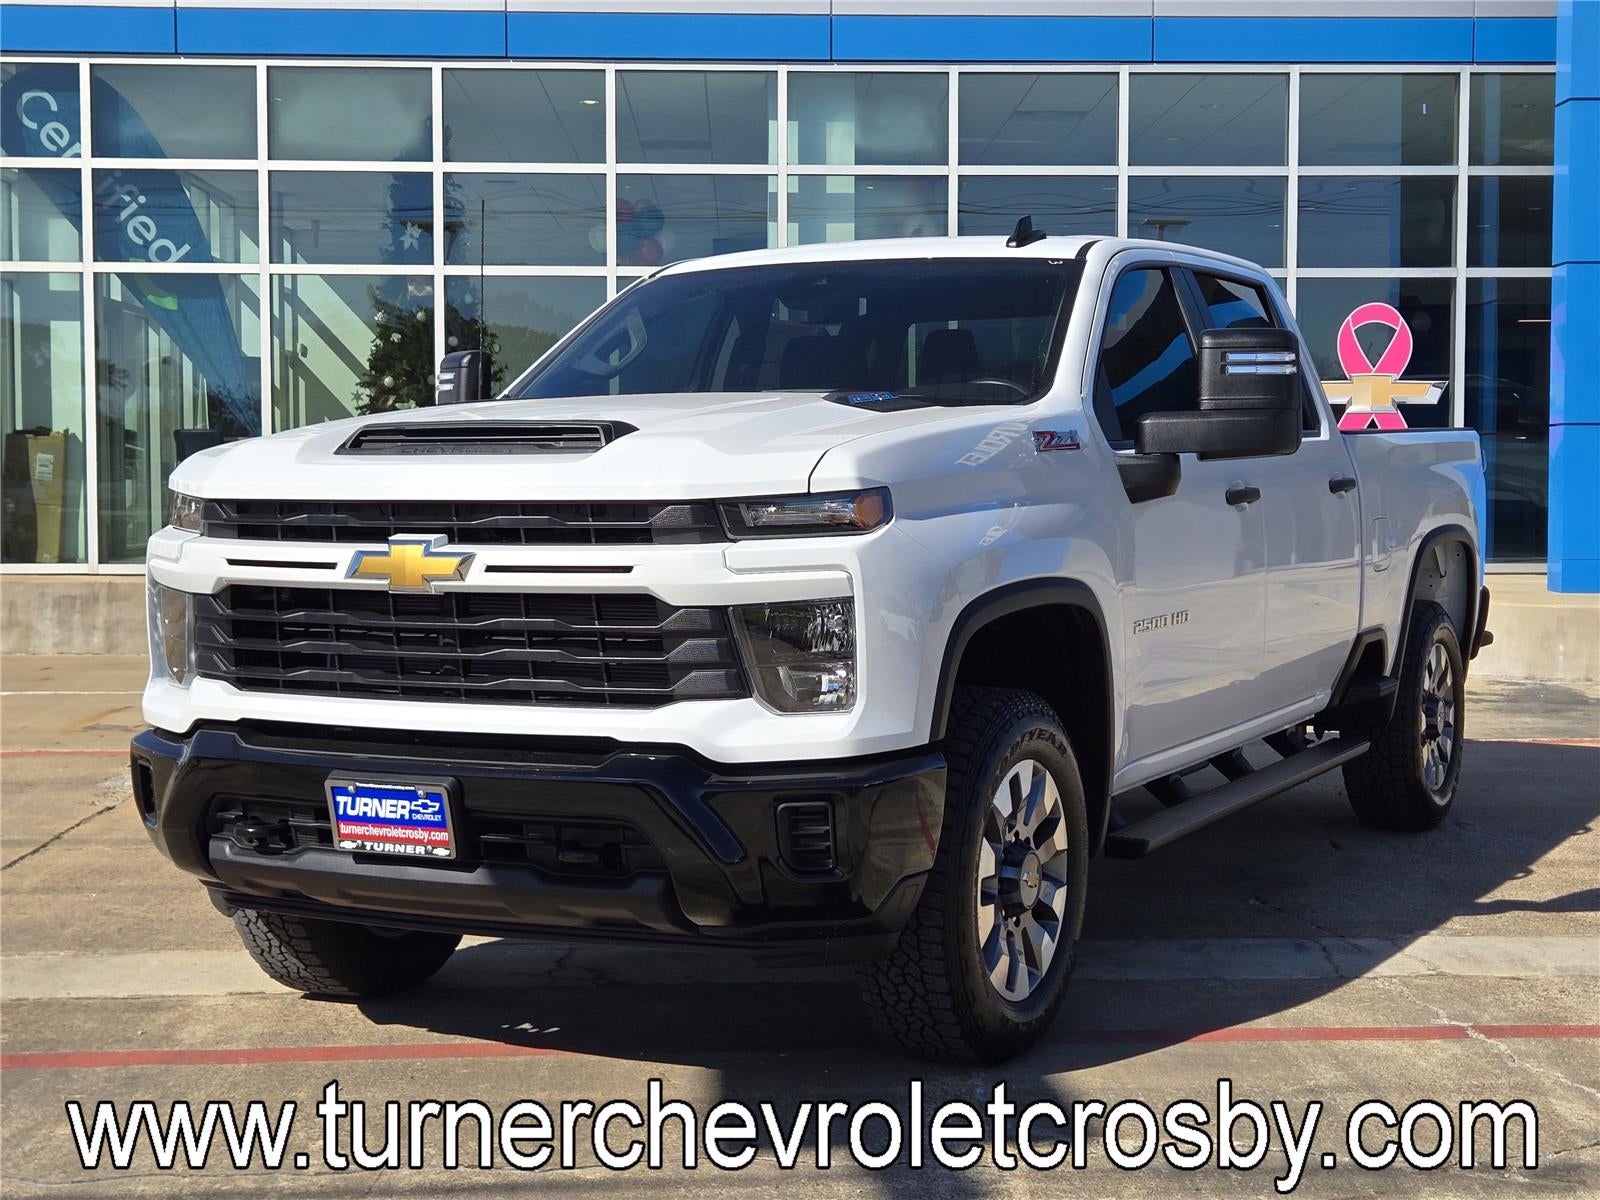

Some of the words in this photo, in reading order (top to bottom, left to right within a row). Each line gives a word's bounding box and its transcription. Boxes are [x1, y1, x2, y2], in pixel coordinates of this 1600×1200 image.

[16, 90, 191, 262] Cerified
[1133, 614, 1169, 635] 2500
[1171, 609, 1190, 626] HD
[335, 795, 411, 820] TURNER
[411, 813, 442, 821] CHEVROLET
[339, 822, 449, 842] turnerchevroletcrosby.com
[364, 841, 426, 855] TURNER
